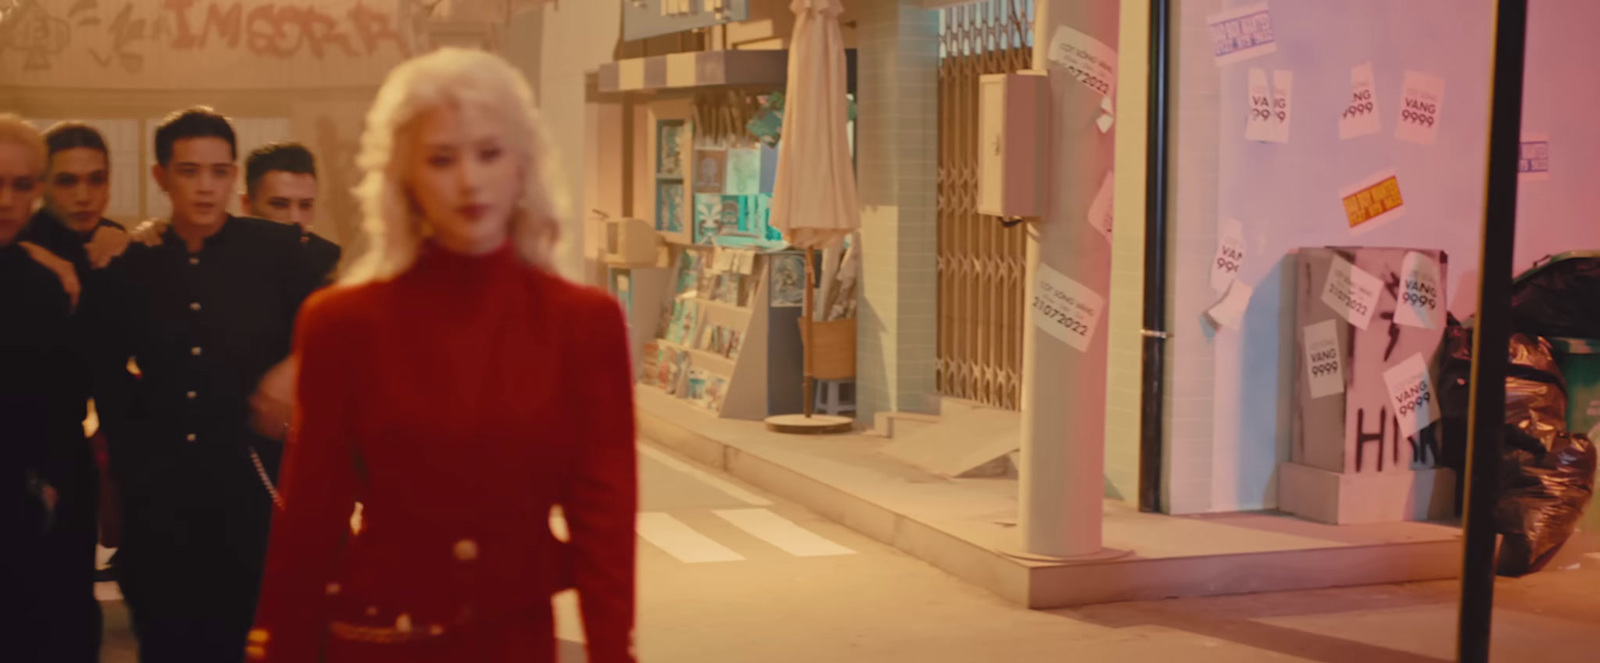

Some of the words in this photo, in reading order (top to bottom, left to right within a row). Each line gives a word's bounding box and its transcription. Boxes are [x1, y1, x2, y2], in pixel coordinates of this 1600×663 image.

[1405, 97, 1436, 115] VANG
[1402, 109, 1435, 128] 9999
[1405, 279, 1437, 298] VANG
[1402, 292, 1437, 311] 9999
[1032, 296, 1088, 337] 21072022
[1311, 348, 1337, 363] VANG
[1312, 361, 1338, 378] 9999
[1395, 380, 1427, 403] VANG
[1400, 391, 1431, 418] 9999
